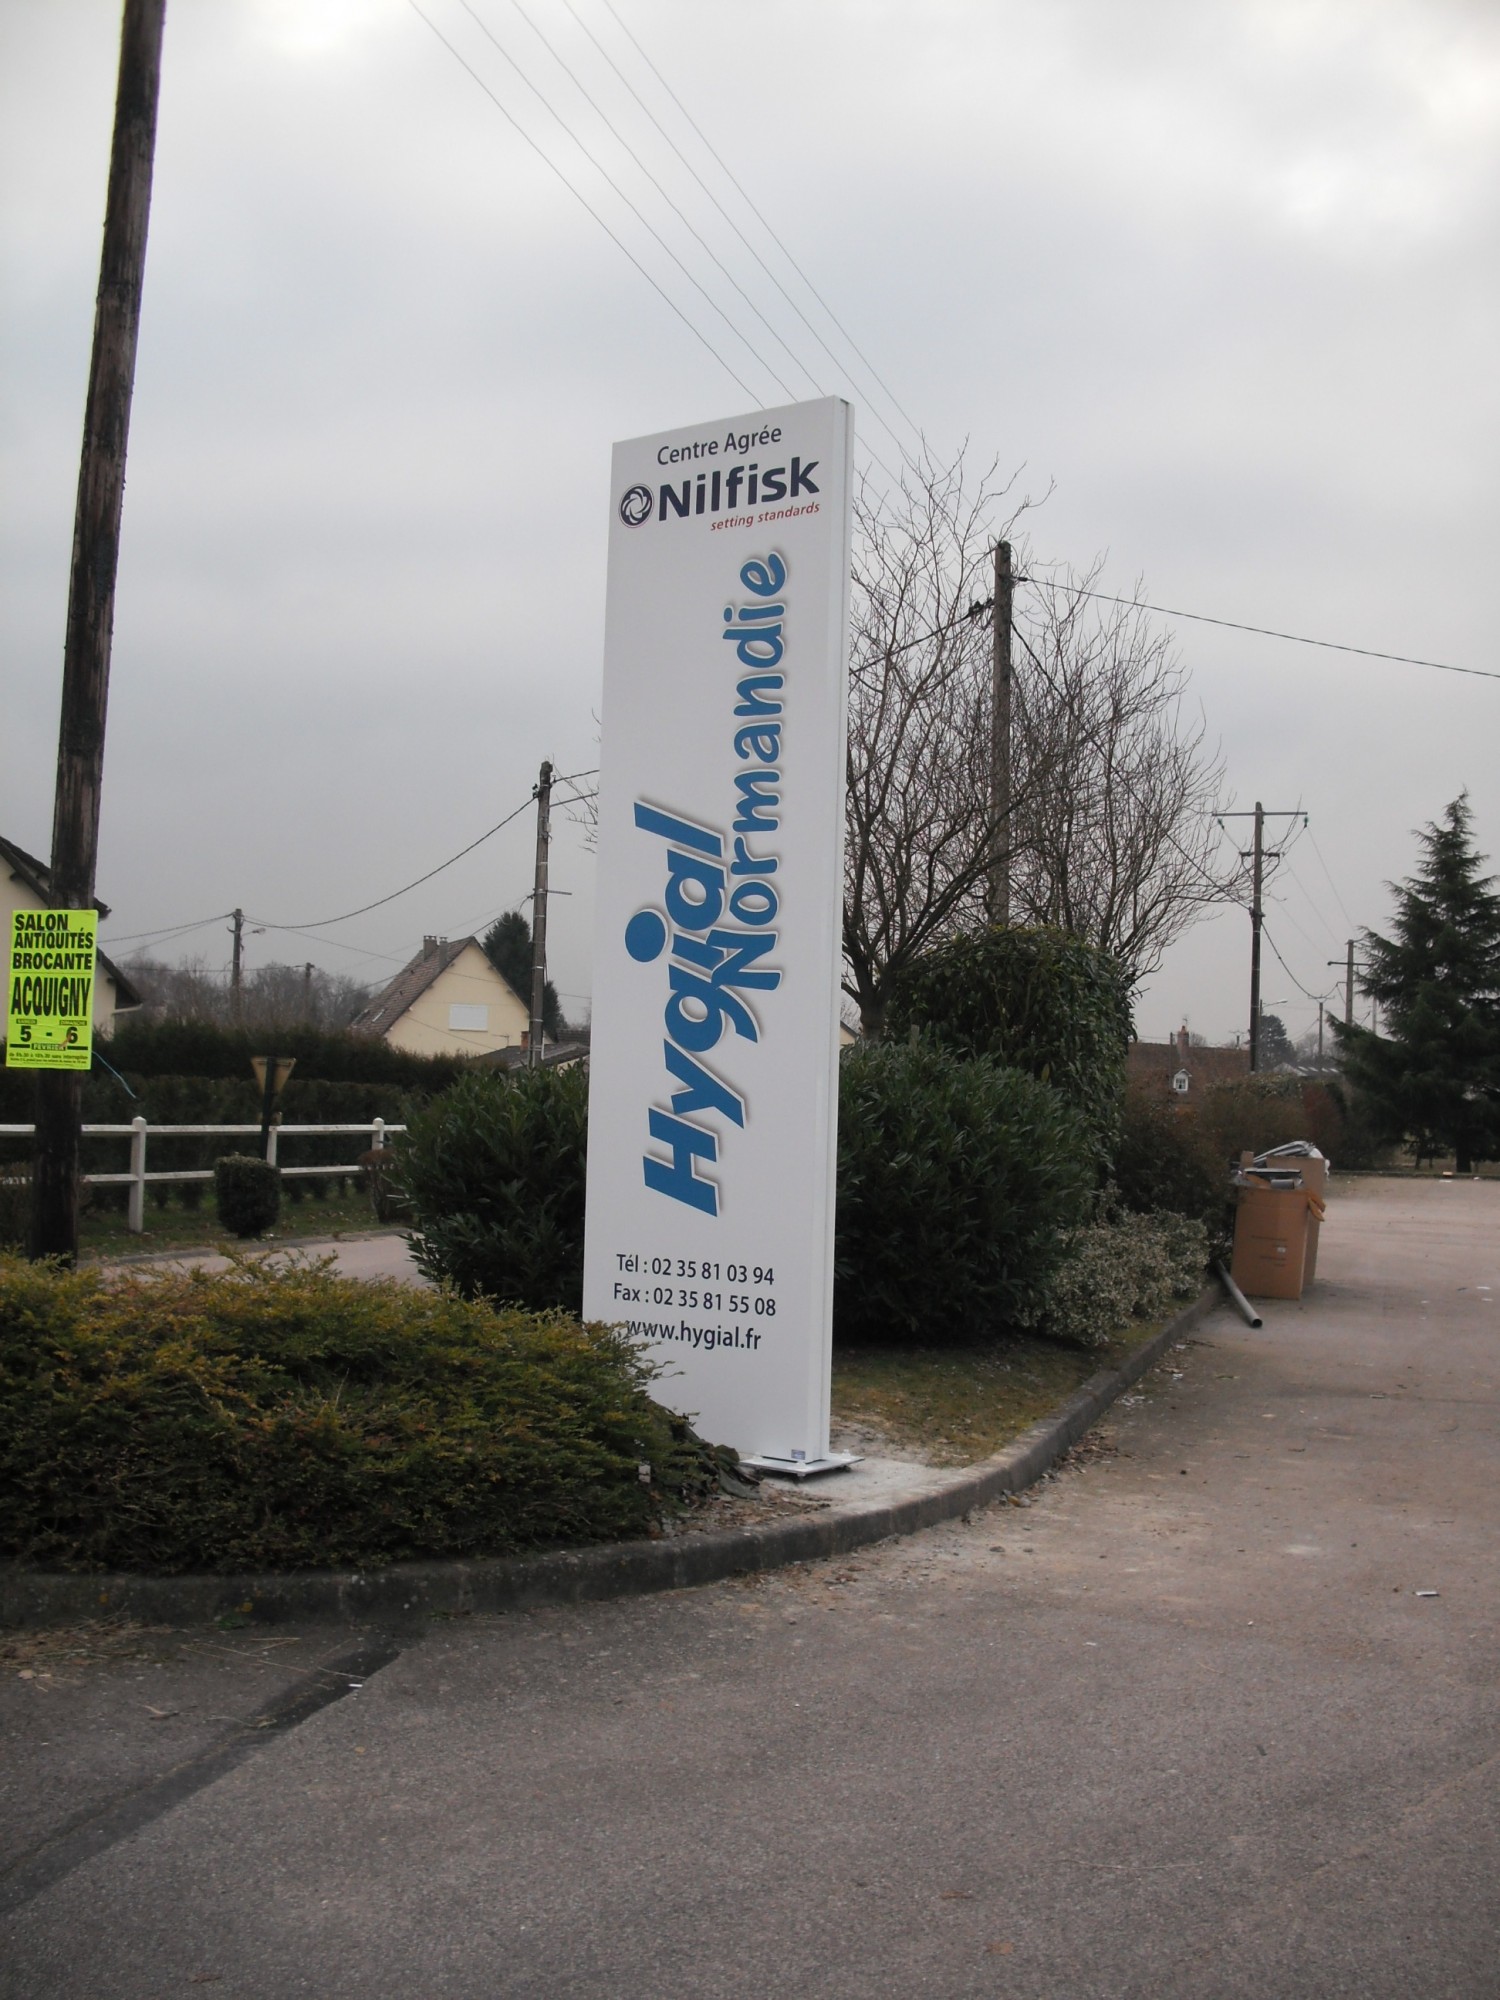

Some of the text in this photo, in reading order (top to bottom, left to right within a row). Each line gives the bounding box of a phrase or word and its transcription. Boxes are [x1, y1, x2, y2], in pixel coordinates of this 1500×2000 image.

[657, 425, 782, 465] Centre Agrée
[659, 457, 820, 521] Nilfisk
[710, 502, 820, 531] setting standards
[705, 551, 786, 990] Normandie
[14, 927, 94, 949] ANTIQUITÉS
[15, 914, 69, 931] SALON
[13, 952, 92, 970] BROCANTE
[11, 976, 91, 1016] ACQUIGNY
[624, 801, 758, 1216] Hygial
[20, 1025, 32, 1042] 5
[66, 1026, 78, 1043] 6
[616, 1254, 638, 1272] Tél
[652, 1258, 671, 1275] 02
[677, 1260, 696, 1278] 35
[702, 1262, 720, 1280] 81
[727, 1265, 747, 1282] 03
[753, 1267, 774, 1285] 94
[614, 1283, 640, 1301] Fax
[653, 1288, 673, 1305] 02
[678, 1290, 698, 1307] 35
[703, 1293, 721, 1310] 81
[728, 1295, 749, 1313] 55
[754, 1299, 776, 1316] 08
[627, 1320, 761, 1350] www.hygial.fr
